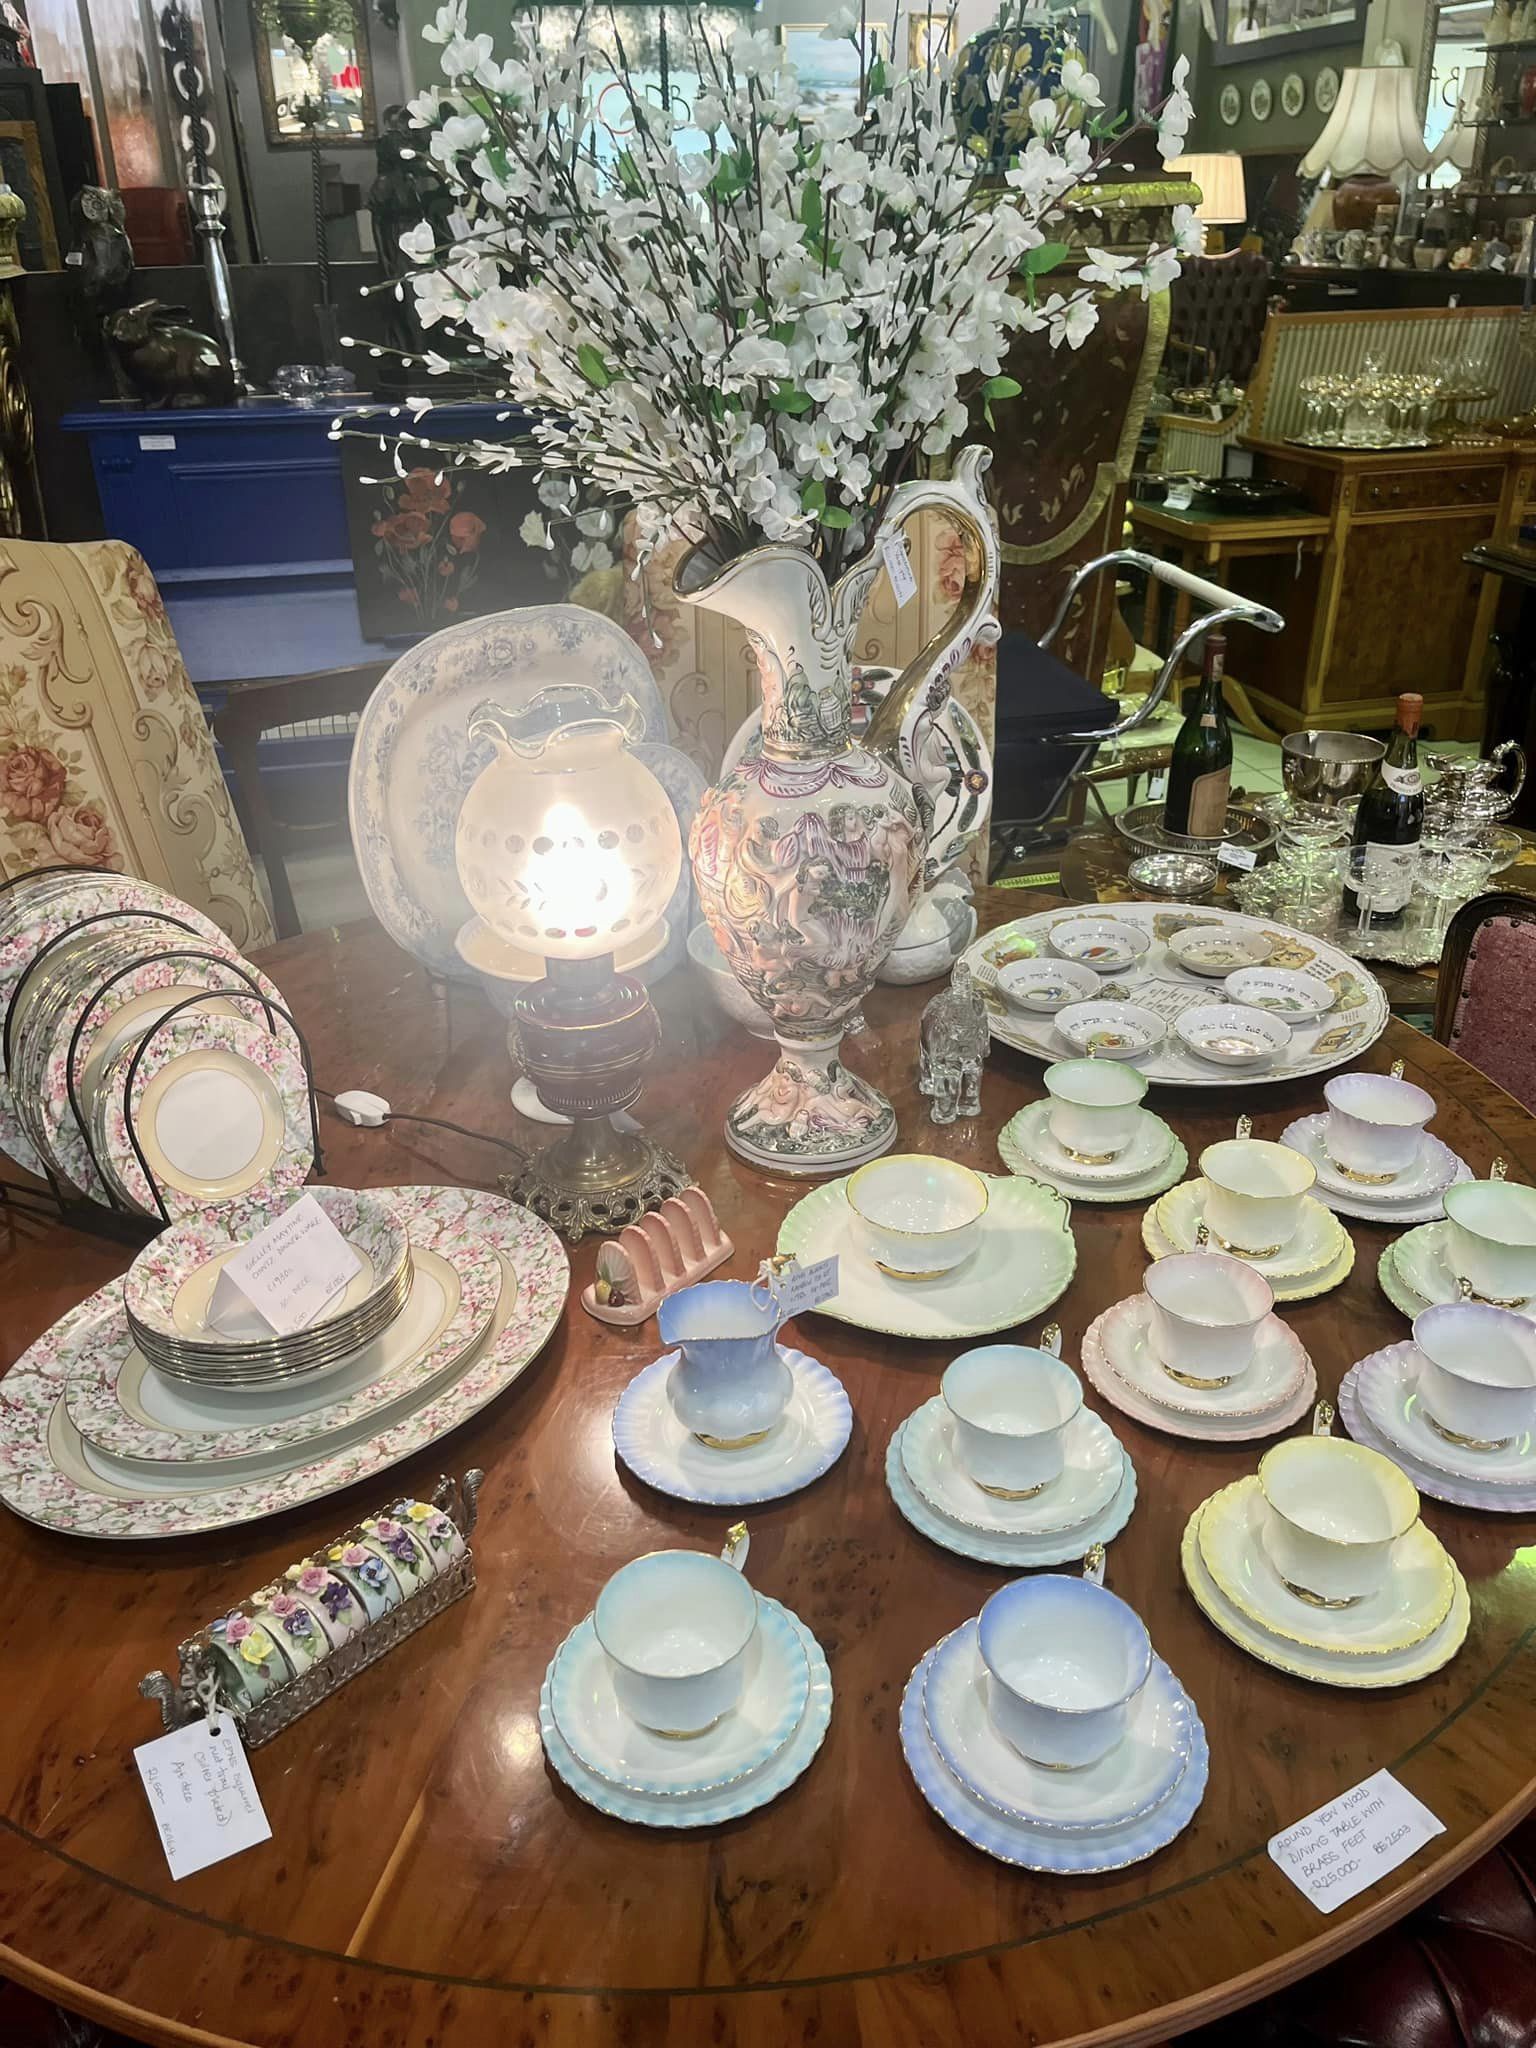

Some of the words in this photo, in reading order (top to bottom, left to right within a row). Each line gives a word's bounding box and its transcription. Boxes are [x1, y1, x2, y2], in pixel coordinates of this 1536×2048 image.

[1340, 1786, 1370, 1809] WOOD
[1288, 1834, 1329, 1863] DINING
[1329, 1814, 1361, 1838] TABLE
[1360, 1798, 1384, 1818] WITH
[1301, 1849, 1339, 1877] BRASS
[1340, 1829, 1368, 1852] FEET
